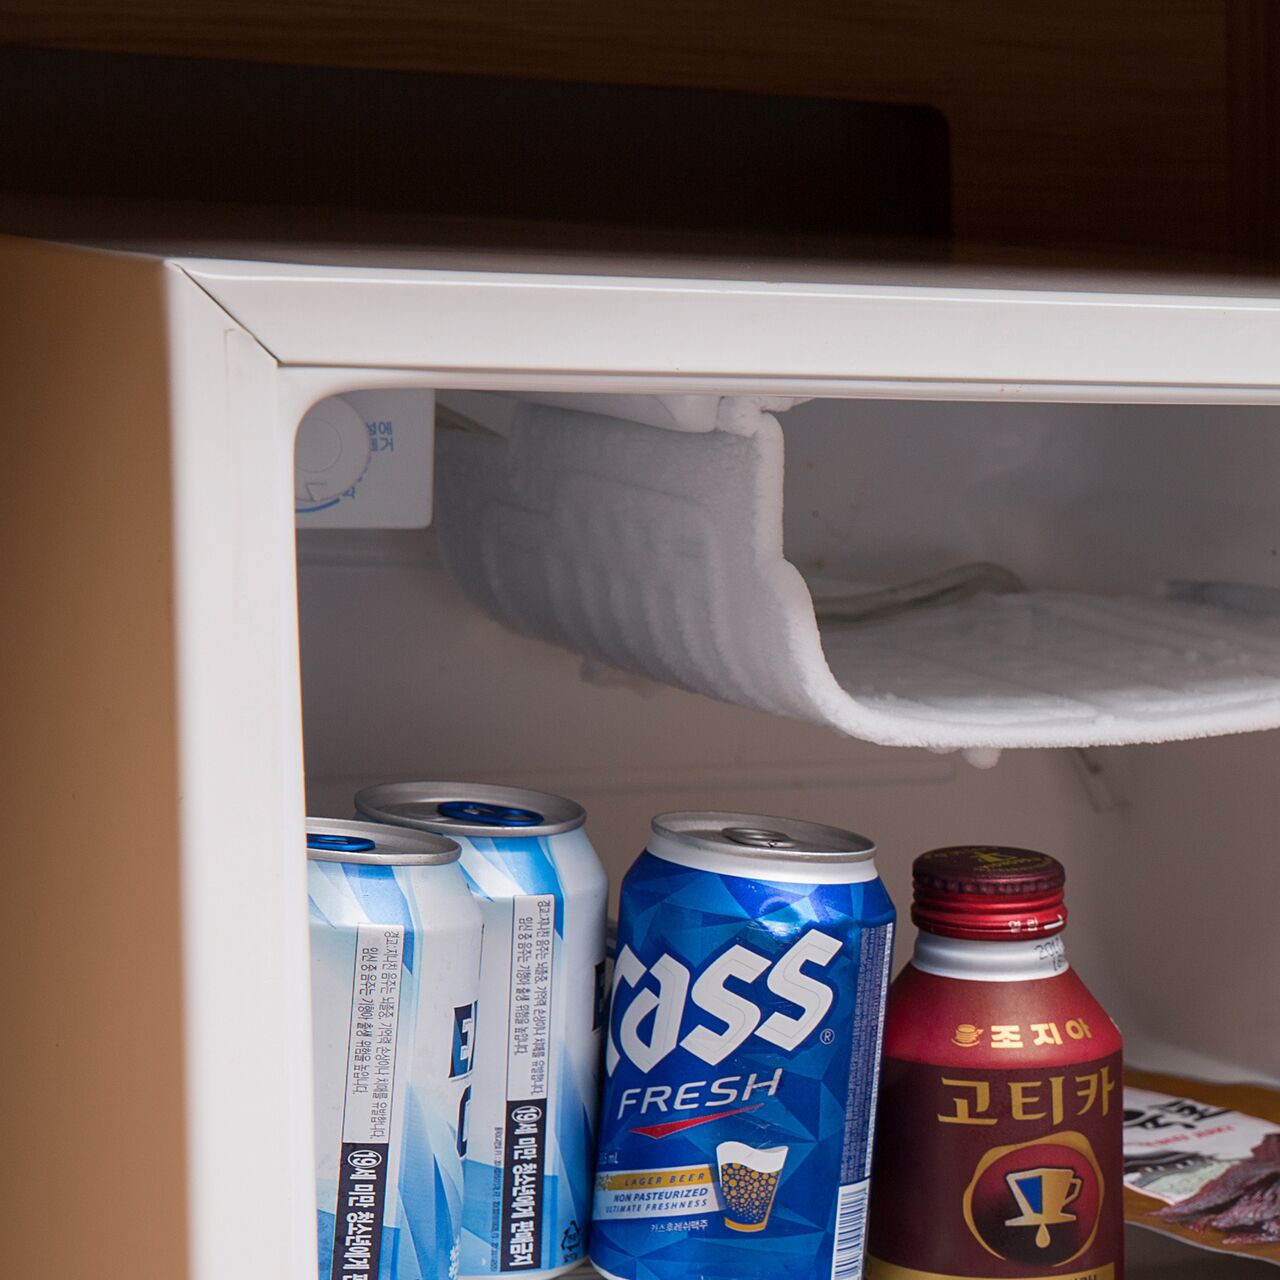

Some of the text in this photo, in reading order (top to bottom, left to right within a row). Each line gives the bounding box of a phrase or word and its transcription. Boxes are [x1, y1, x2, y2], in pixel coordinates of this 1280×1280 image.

[380, 973, 397, 994] 음주는
[352, 948, 376, 1095] 임신 중 음주는 기형아 출생 위험을 높입니다.
[376, 1022, 394, 1044] 기억력
[375, 1047, 391, 1075] 손상이나
[373, 1078, 389, 1099] 치매를
[617, 1068, 783, 1120] FRESH
[937, 1066, 1116, 1127] 고티카
[370, 1101, 388, 1139] 유발합니다.
[512, 1138, 537, 1159] 미만
[510, 1162, 536, 1218] 청소년에게
[625, 1173, 705, 1186] LAGER BEER
[348, 1184, 377, 1207] 미만
[606, 1199, 707, 1213] ULTIMATE FRESHNESS
[614, 1188, 708, 1202] NON PASTEURIZED
[345, 1211, 375, 1268] 청소년에게
[509, 1221, 533, 1266] 판매금지
